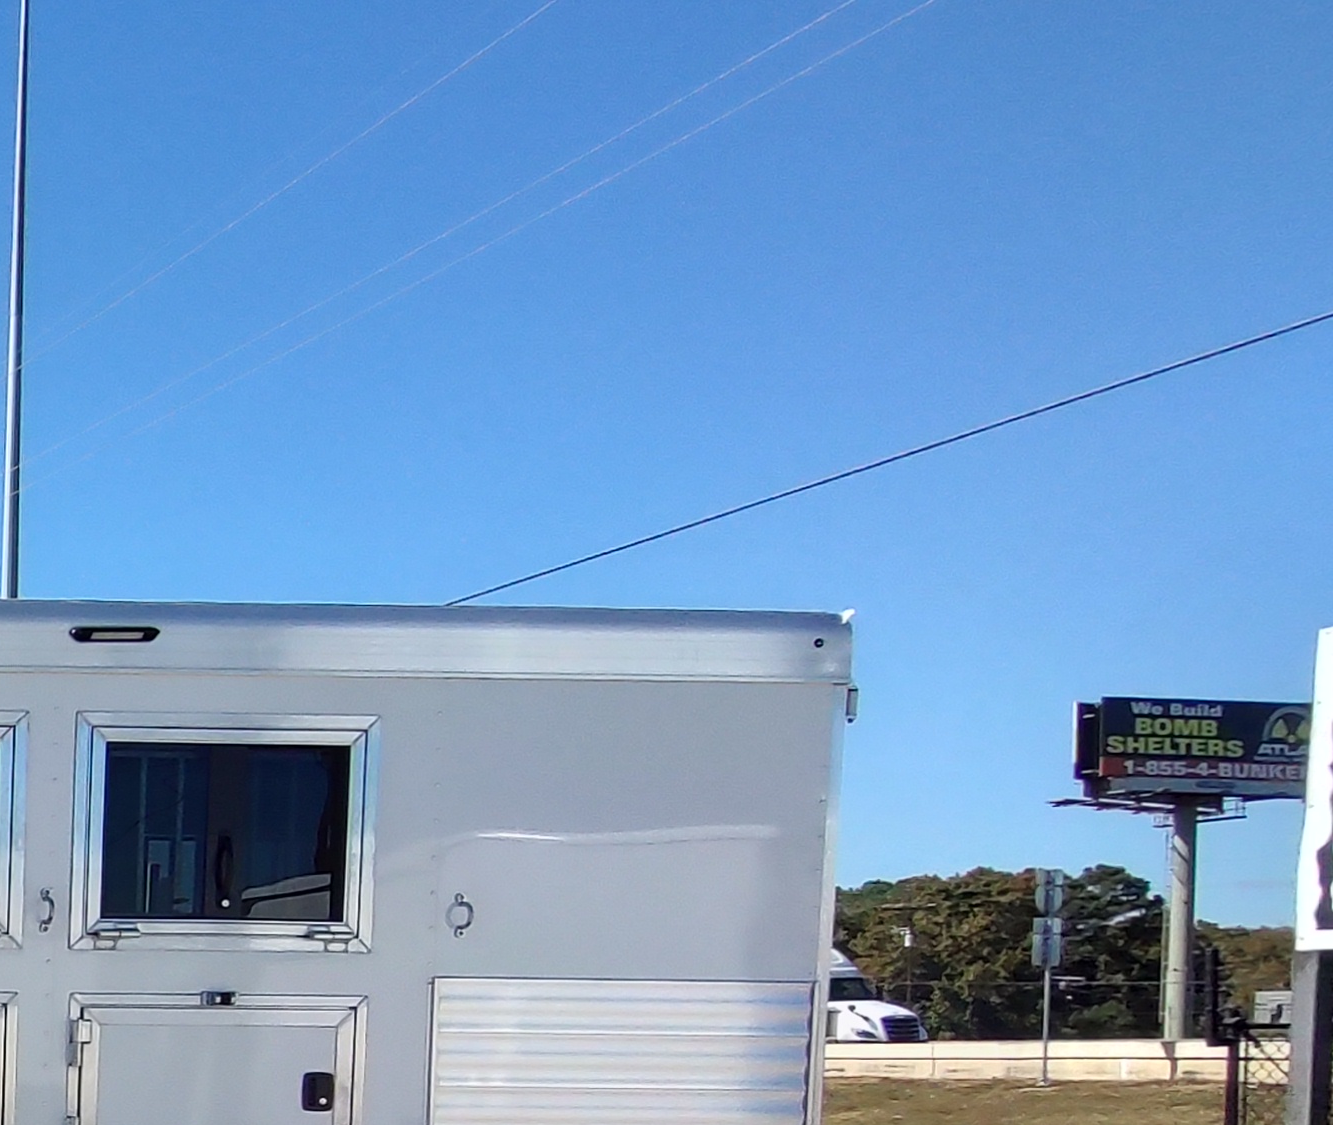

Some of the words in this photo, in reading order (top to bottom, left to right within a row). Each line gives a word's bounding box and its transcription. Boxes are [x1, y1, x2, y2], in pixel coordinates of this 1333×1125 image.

[1131, 702, 1163, 716] We
[1170, 703, 1223, 717] Build
[1135, 718, 1218, 737] BOMB
[1106, 736, 1244, 758] SHELTERS
